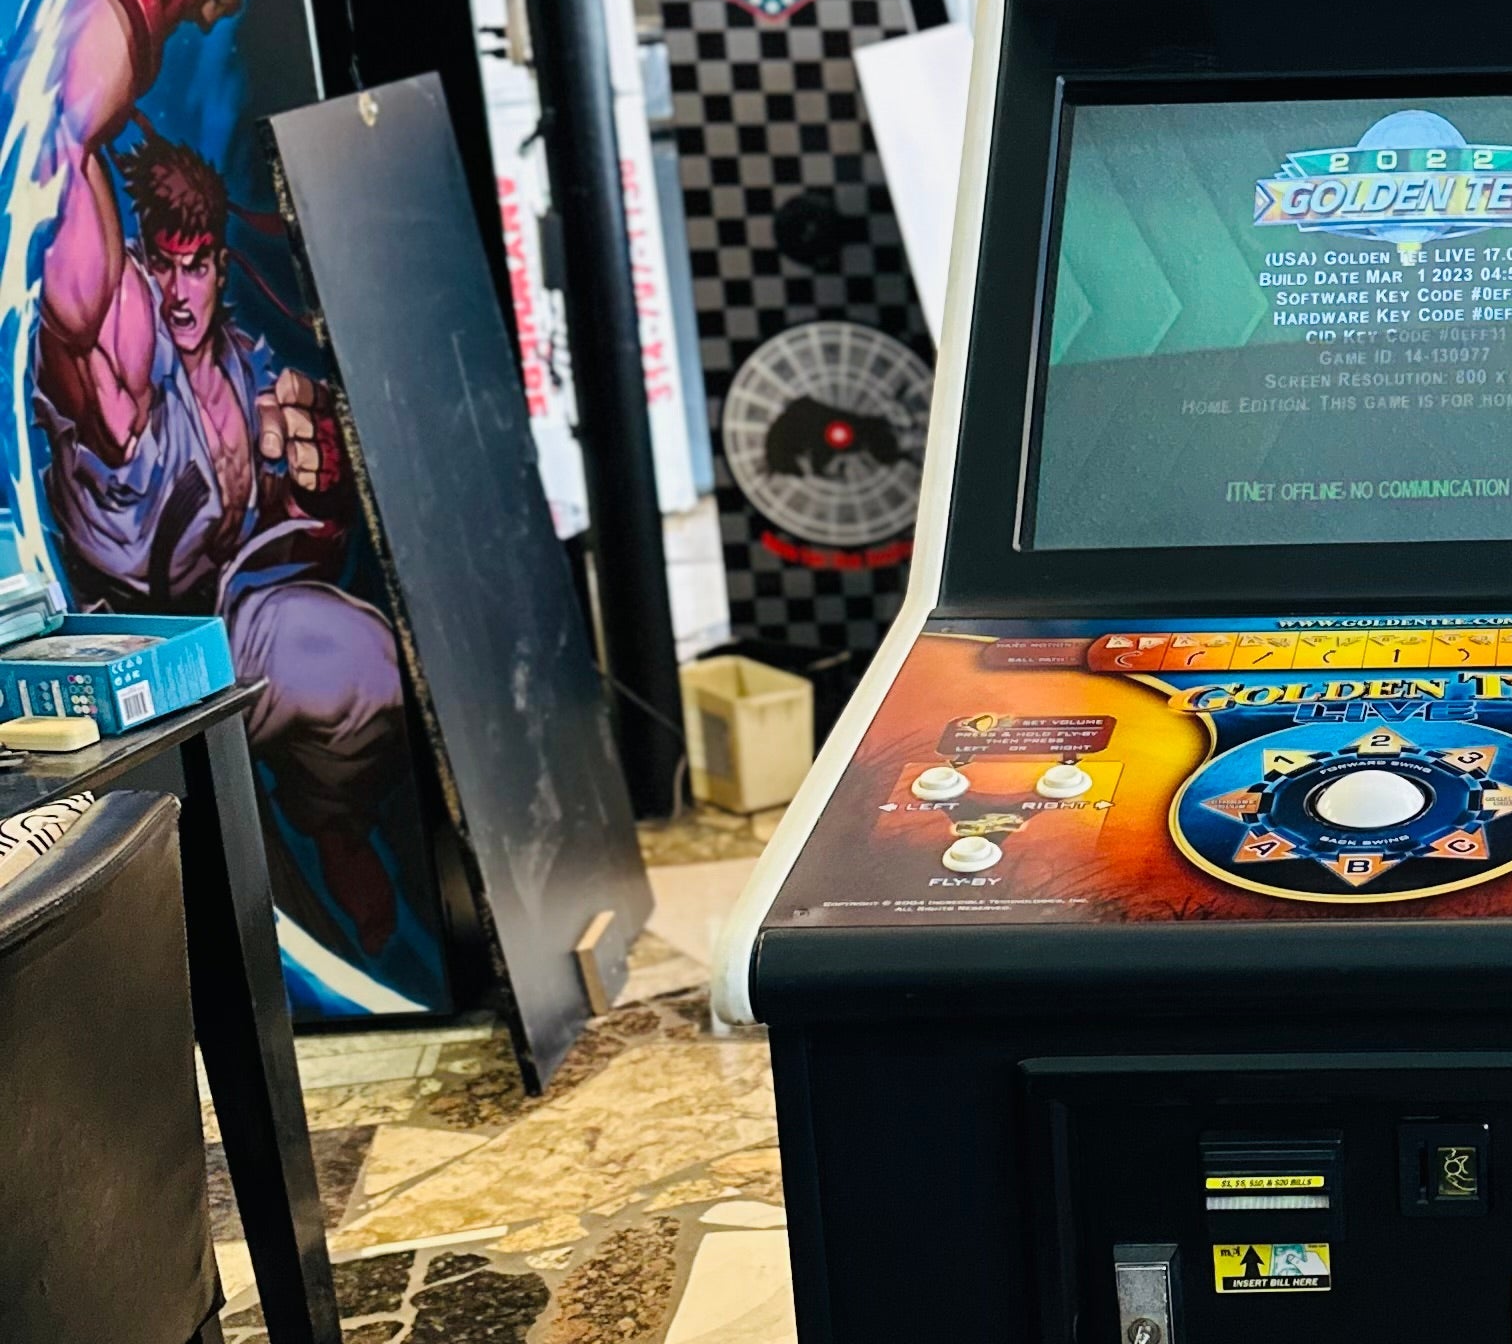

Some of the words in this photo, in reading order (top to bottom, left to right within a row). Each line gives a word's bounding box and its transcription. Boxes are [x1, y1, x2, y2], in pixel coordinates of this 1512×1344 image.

[1280, 177, 1456, 216] GOLDEN
[1265, 251, 1317, 267] (USA)
[1323, 250, 1390, 265] GOLDEN
[1434, 248, 1476, 263] LIVE
[1259, 271, 1308, 287] BUILD
[1314, 270, 1360, 285] DATE
[1366, 269, 1403, 284] MAR
[1417, 268, 1425, 283] 1
[1432, 267, 1473, 282] 2023
[1276, 291, 1369, 306] SOFTWARE
[1375, 289, 1410, 303] KEY
[1417, 287, 1463, 302] CODE
[1273, 311, 1370, 326] HARDWARE
[1376, 308, 1411, 323] KEY
[1418, 307, 1465, 322] CODE
[1305, 329, 1337, 345] CID
[1319, 350, 1366, 366] GAME
[1264, 373, 1331, 389] SCREEN
[1455, 369, 1487, 385] 800
[1350, 480, 1374, 500] NO
[1379, 478, 1511, 500] COMMUNICATION
[1167, 677, 1449, 713] GOLDEN
[1292, 699, 1479, 724] LIVE
[1369, 732, 1392, 748] 2
[1274, 754, 1296, 766] 1
[1457, 750, 1484, 765] 3
[905, 802, 961, 812] LEFT
[1021, 801, 1091, 811] RIGHT
[1248, 839, 1278, 858] A
[1446, 838, 1477, 855] C
[1345, 858, 1371, 874] B
[928, 876, 1003, 888] FLY-BY
[1232, 1278, 1268, 1288] INSERT
[1270, 1278, 1291, 1287] BILL
[1292, 1277, 1319, 1287] HERE
